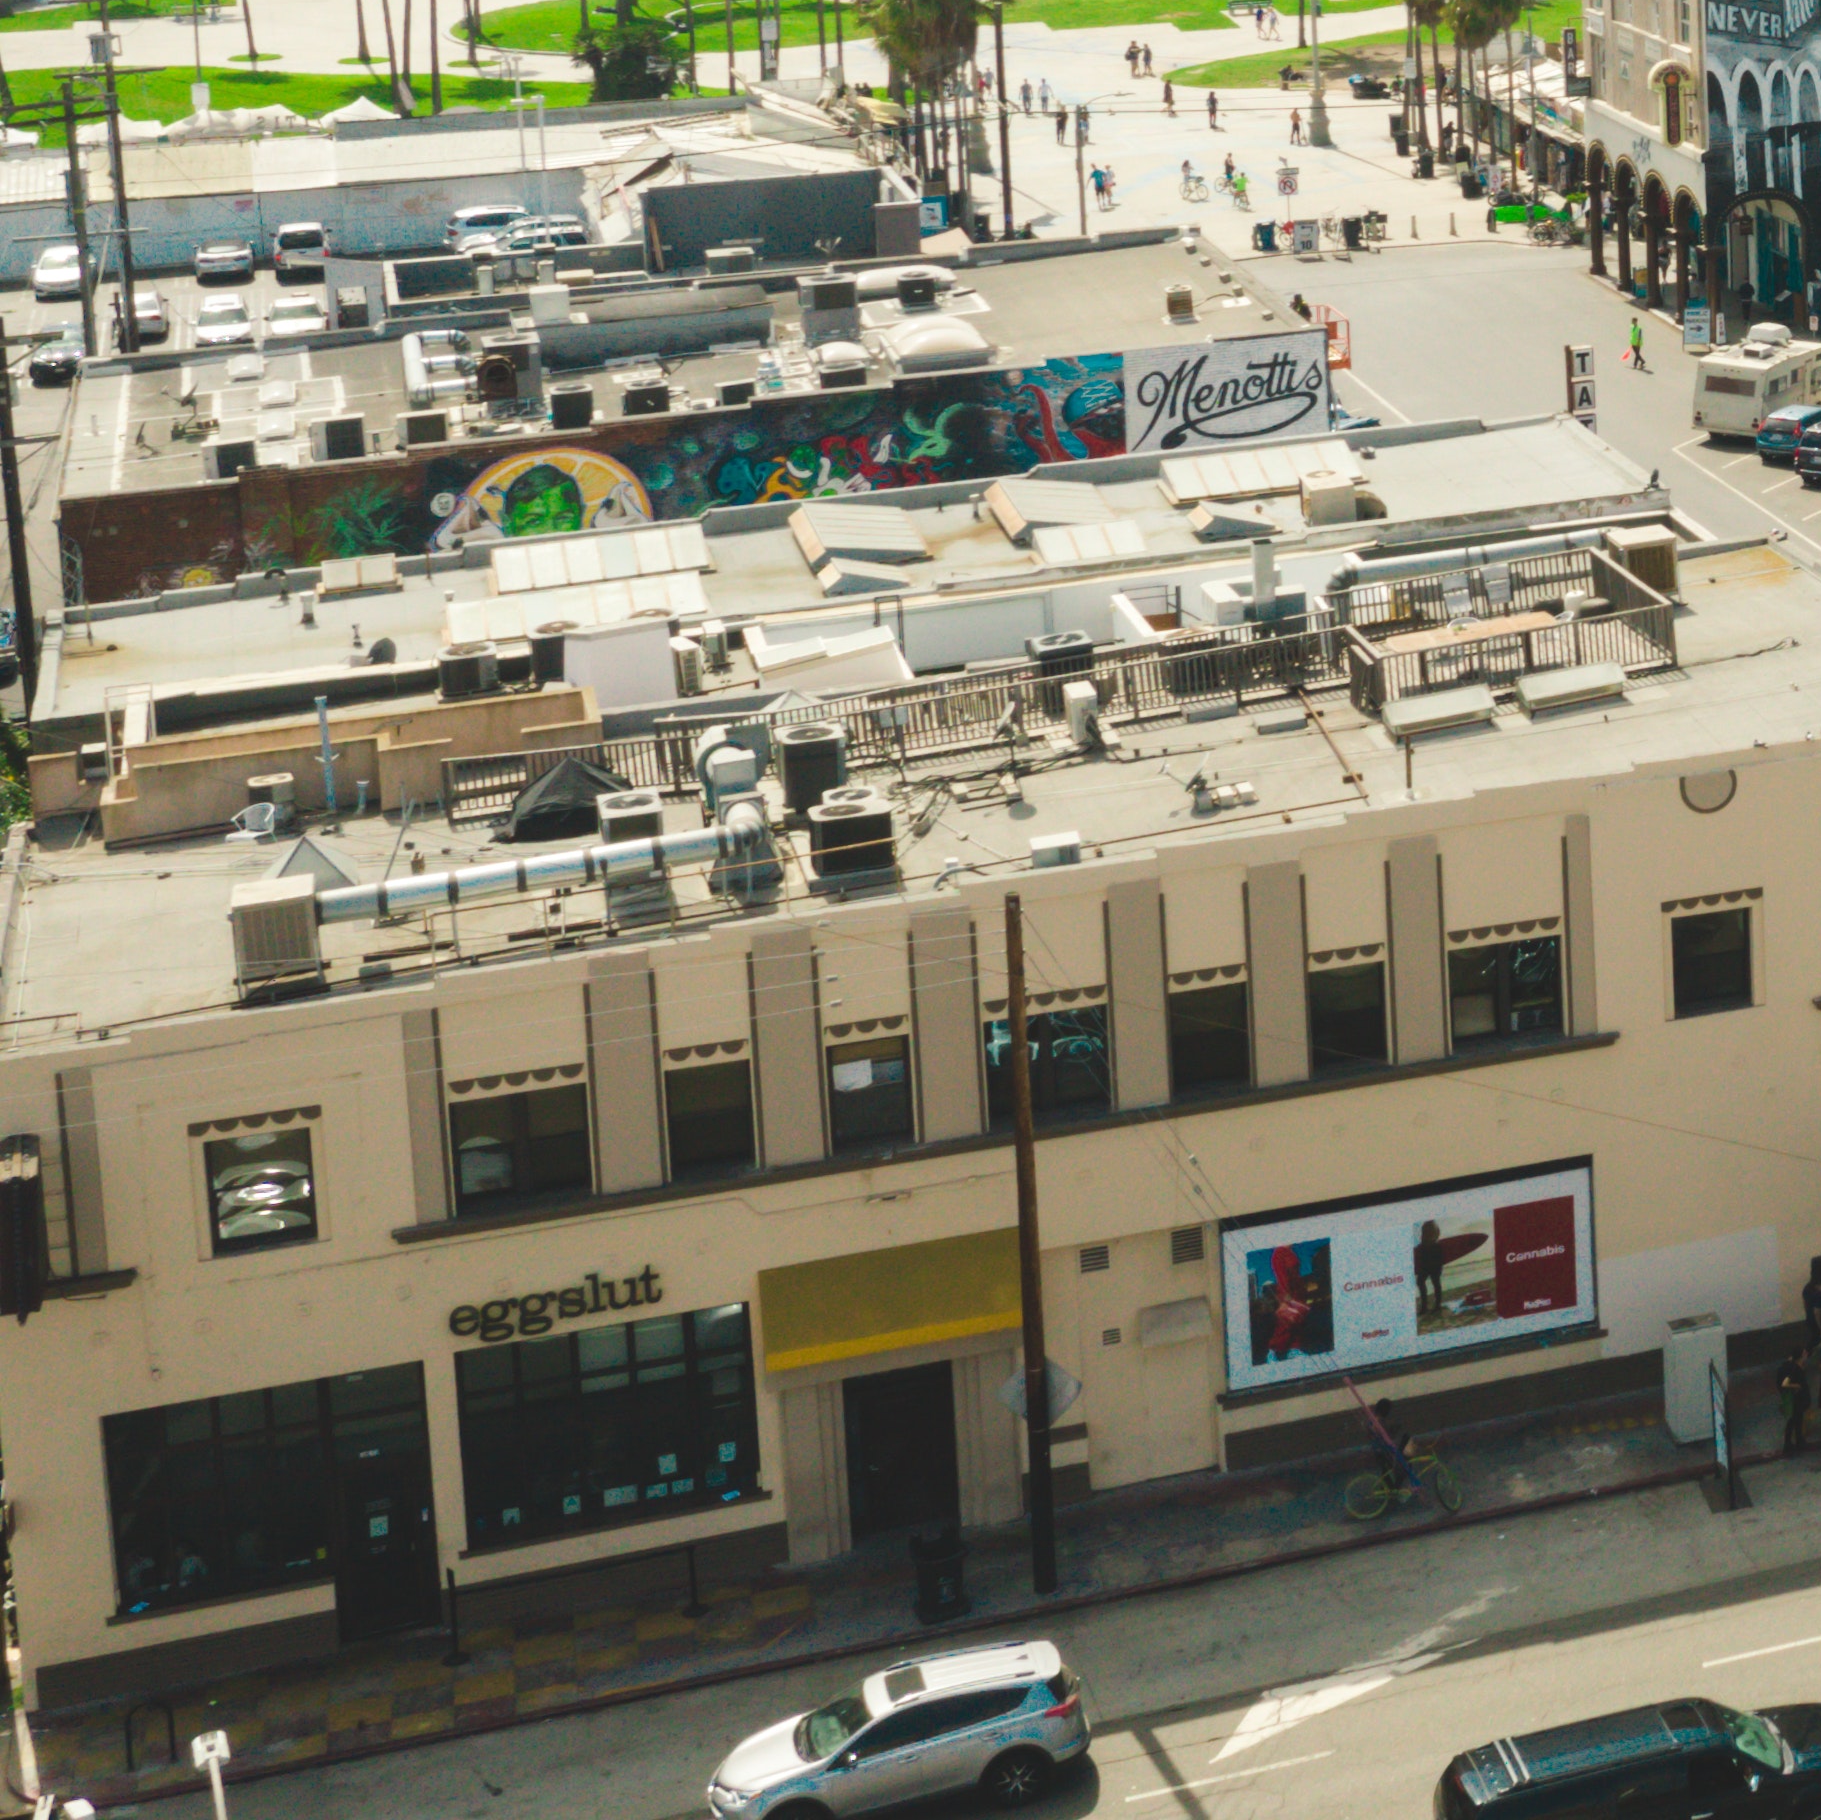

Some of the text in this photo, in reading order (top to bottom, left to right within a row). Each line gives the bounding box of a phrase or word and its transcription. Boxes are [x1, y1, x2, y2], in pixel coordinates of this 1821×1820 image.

[1707, 1, 1783, 38] NEVER
[1566, 32, 1576, 76] BAR
[1301, 239, 1312, 250] 10
[1505, 1244, 1565, 1263] Cannabis
[1343, 1275, 1404, 1293] Cannabis
[449, 1264, 663, 1342] eggslut
